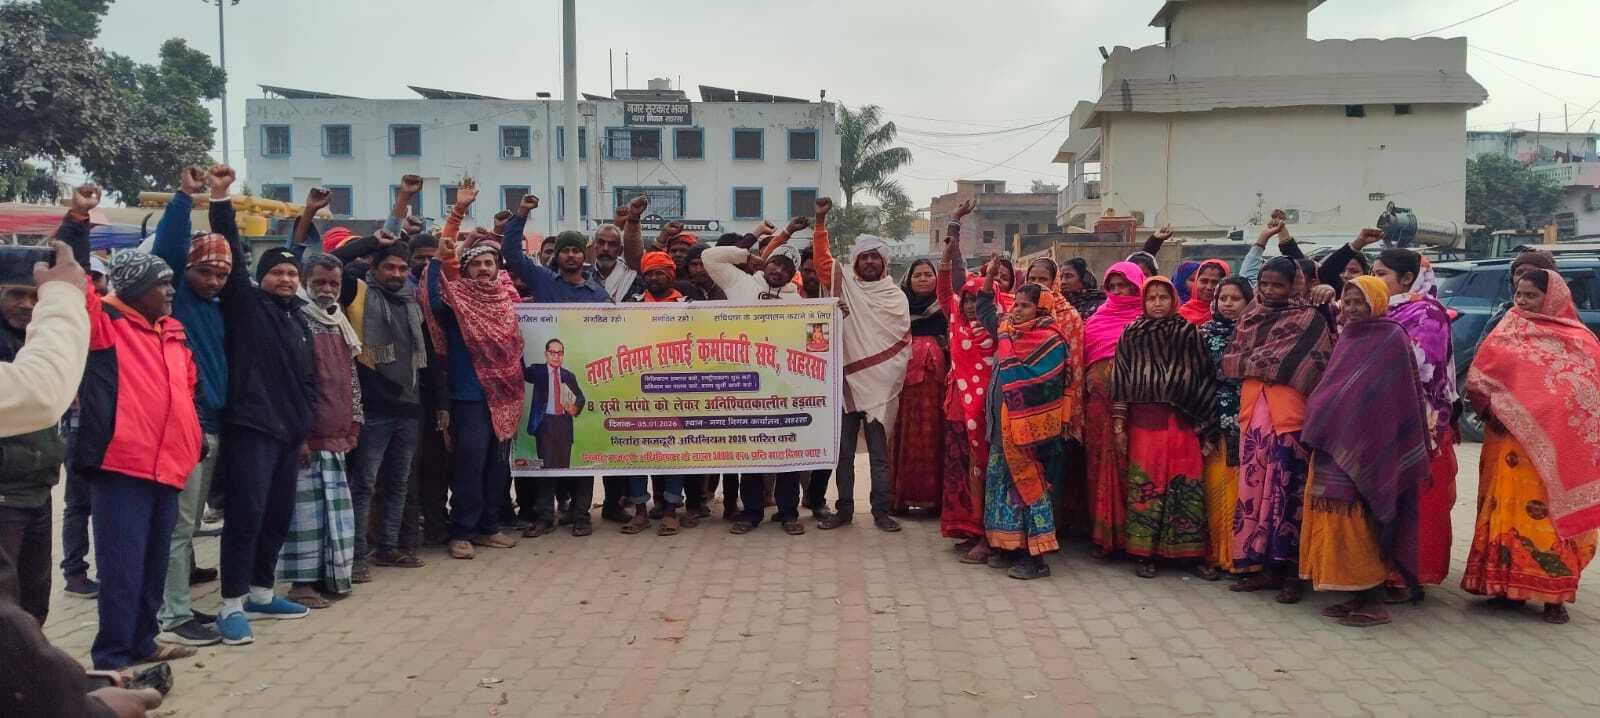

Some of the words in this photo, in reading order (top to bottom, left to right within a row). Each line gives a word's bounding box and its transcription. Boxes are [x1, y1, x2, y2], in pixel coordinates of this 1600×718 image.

[626, 103, 644, 113] नगर
[645, 103, 670, 113] सरकार
[671, 104, 688, 114] भवन
[753, 312, 784, 323] अनुपालन
[817, 311, 831, 319] लिए
[585, 356, 613, 384] नगर
[617, 345, 653, 376] निगम
[656, 332, 693, 368] सफाई
[755, 336, 780, 375] संघ,
[787, 348, 827, 381] सहरसा
[588, 401, 594, 411] 8
[600, 398, 619, 415] सूत्री
[654, 397, 668, 410] को
[673, 396, 699, 411] लेकर
[705, 395, 788, 410] अनिश्चितकालीन
[792, 395, 826, 410] हड़ताल
[710, 418, 726, 426] नगर
[728, 417, 748, 425] निगम
[784, 416, 808, 424] सहरसा
[678, 434, 726, 445] अधिनियम
[728, 434, 746, 443] 2026
[749, 433, 775, 443] पारित
